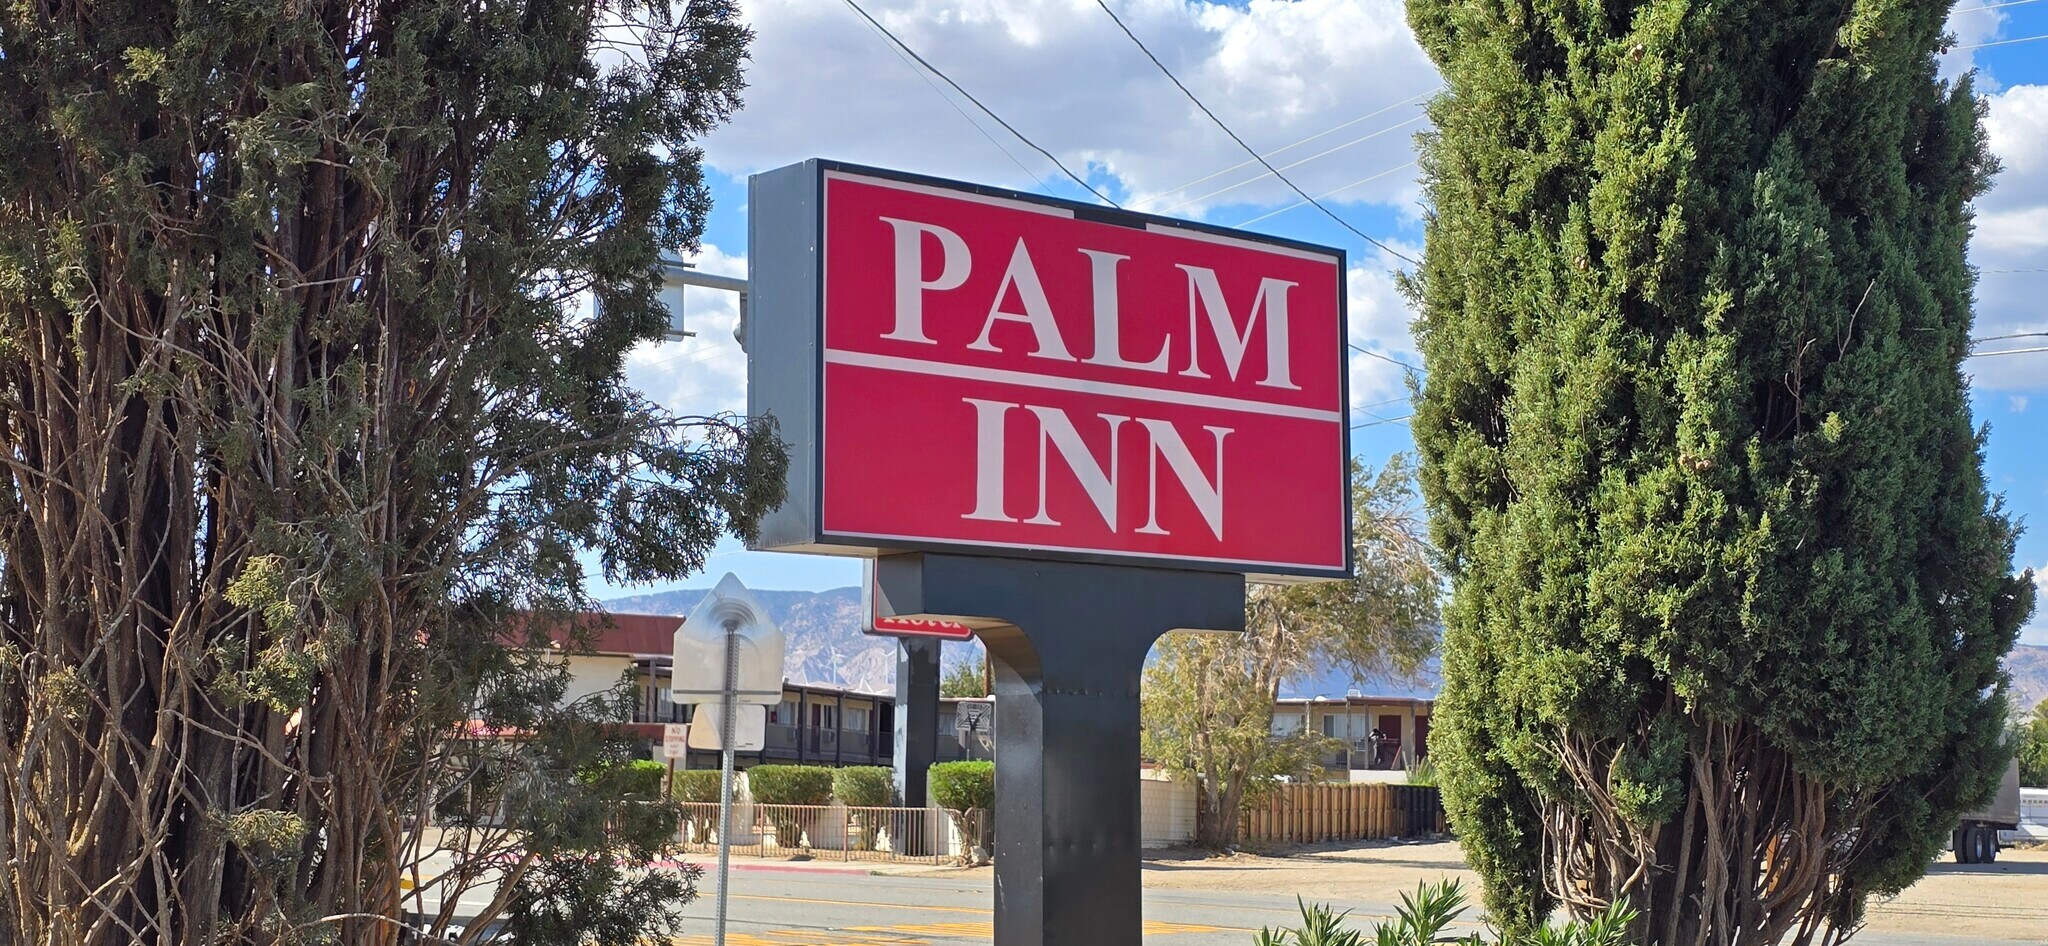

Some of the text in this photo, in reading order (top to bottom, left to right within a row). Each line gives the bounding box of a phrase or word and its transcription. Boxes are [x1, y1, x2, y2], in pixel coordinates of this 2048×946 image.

[880, 216, 1302, 390] PALM
[961, 398, 1235, 542] INN
[671, 727, 681, 735] NO
